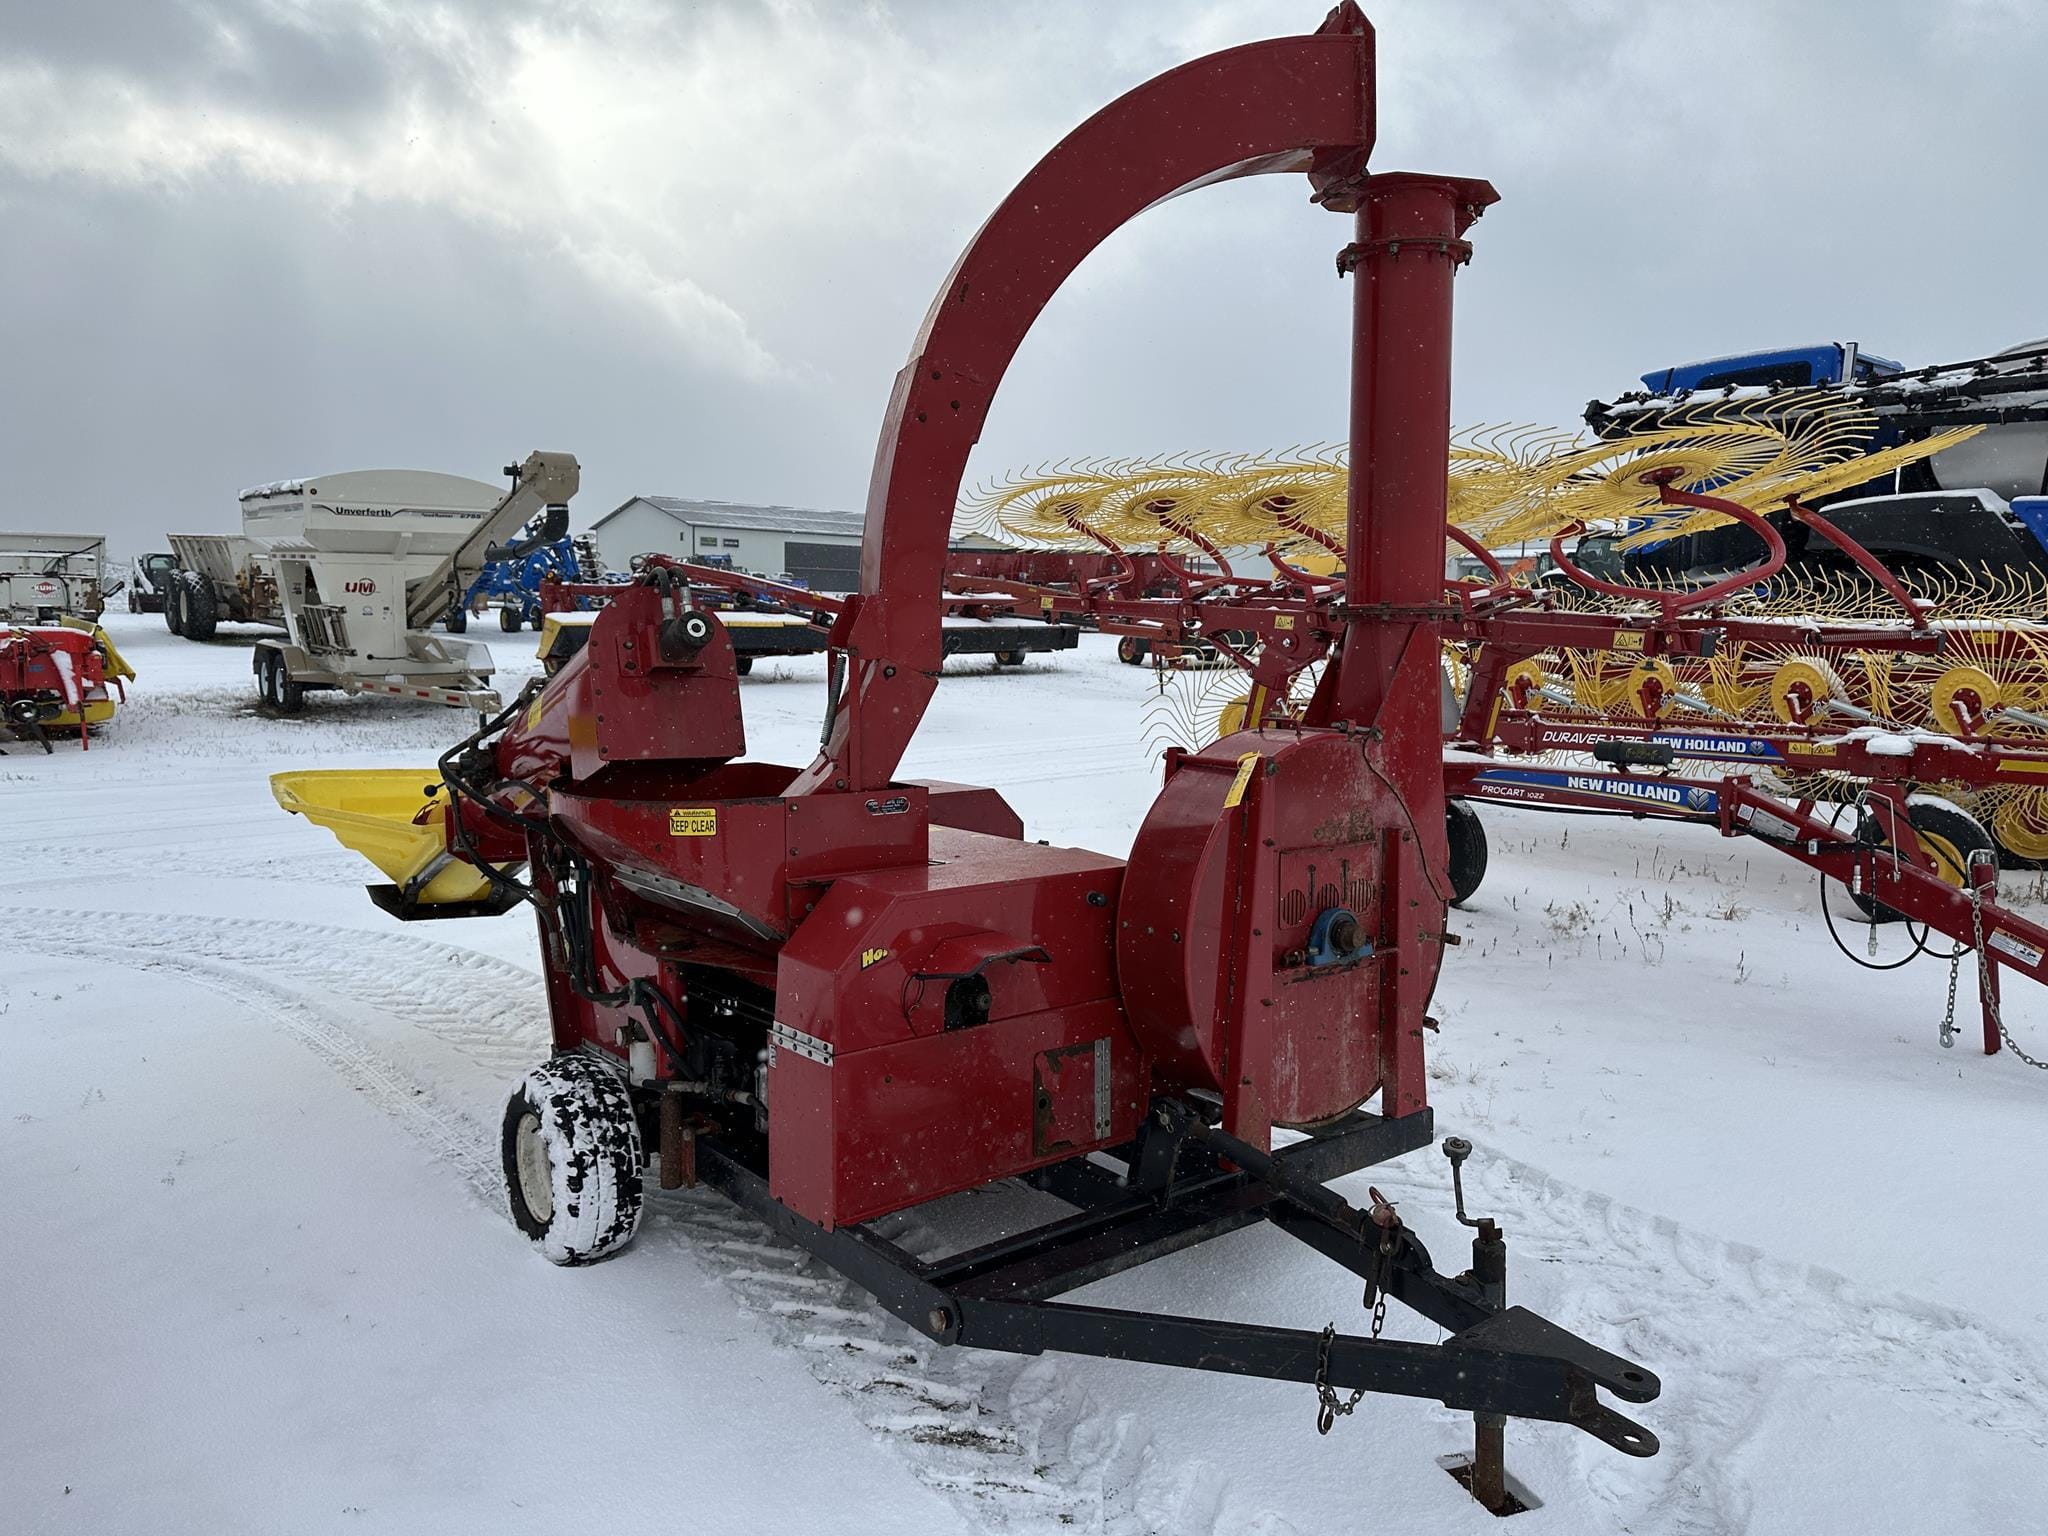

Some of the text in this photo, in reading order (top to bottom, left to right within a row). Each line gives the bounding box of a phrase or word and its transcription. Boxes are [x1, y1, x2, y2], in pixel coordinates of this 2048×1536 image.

[336, 506, 392, 517] Unverferth
[1652, 736, 1747, 754] NEW HOLLAND
[1481, 784, 1526, 798] PROCART
[1567, 776, 1681, 803] NEW HOLLAND
[671, 819, 715, 833] KEEP CLEAR
